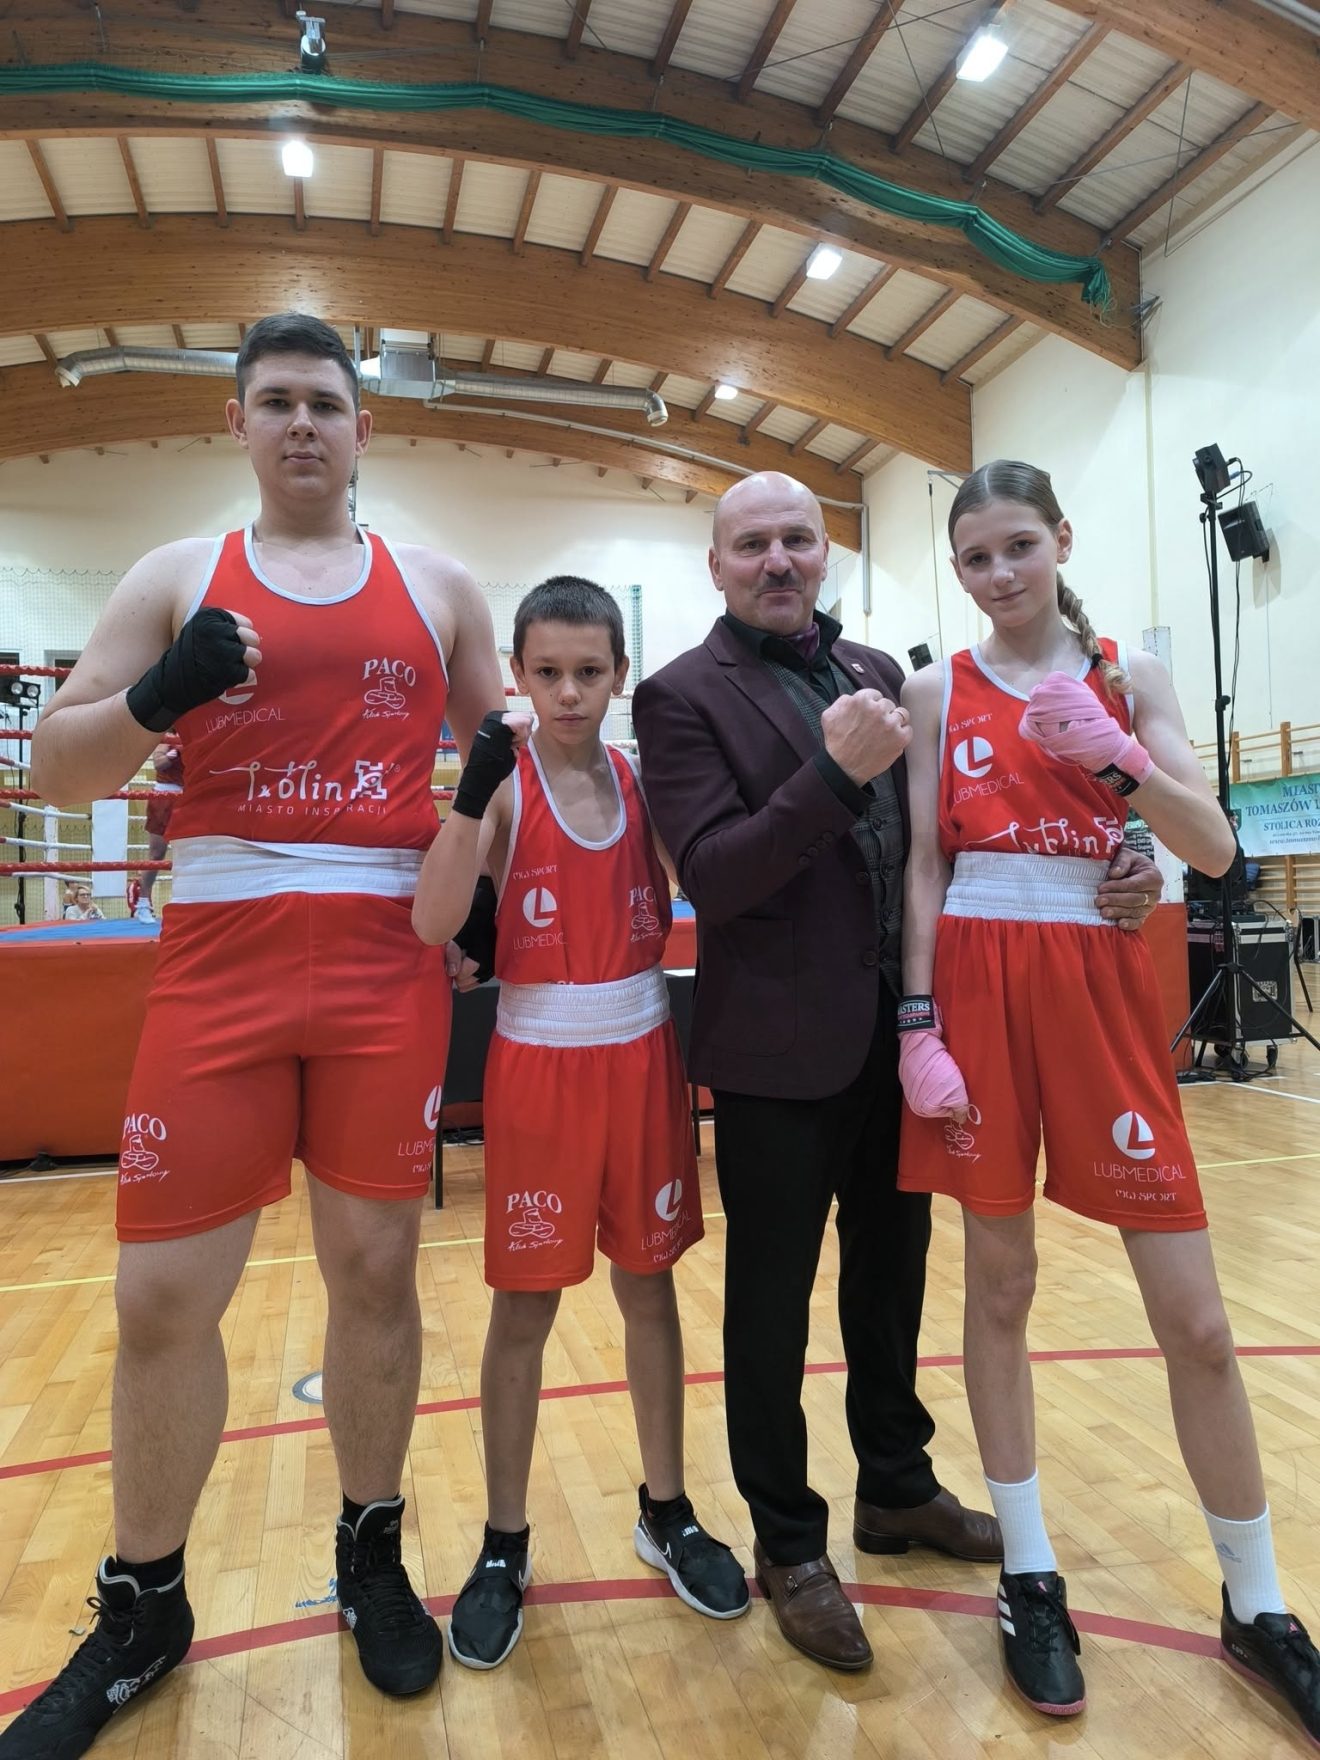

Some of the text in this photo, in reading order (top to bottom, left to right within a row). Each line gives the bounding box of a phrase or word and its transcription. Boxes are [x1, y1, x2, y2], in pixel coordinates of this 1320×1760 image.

[362, 656, 416, 688] PACO
[205, 707, 286, 734] LUBMEDICAL
[952, 771, 1025, 806] UBMEDICAL
[237, 804, 388, 816] MIASTO INSPRACJI
[1246, 799, 1311, 817] TOMASZÓW
[1263, 820, 1303, 831] STOLICA
[513, 931, 568, 951] LUBMEDIC
[898, 1002, 931, 1014] STERS
[122, 1113, 167, 1141] PACO
[1094, 1161, 1187, 1183] LUBMEDICAL
[506, 1190, 563, 1214] PACO
[1138, 1191, 1177, 1201] SPORT
